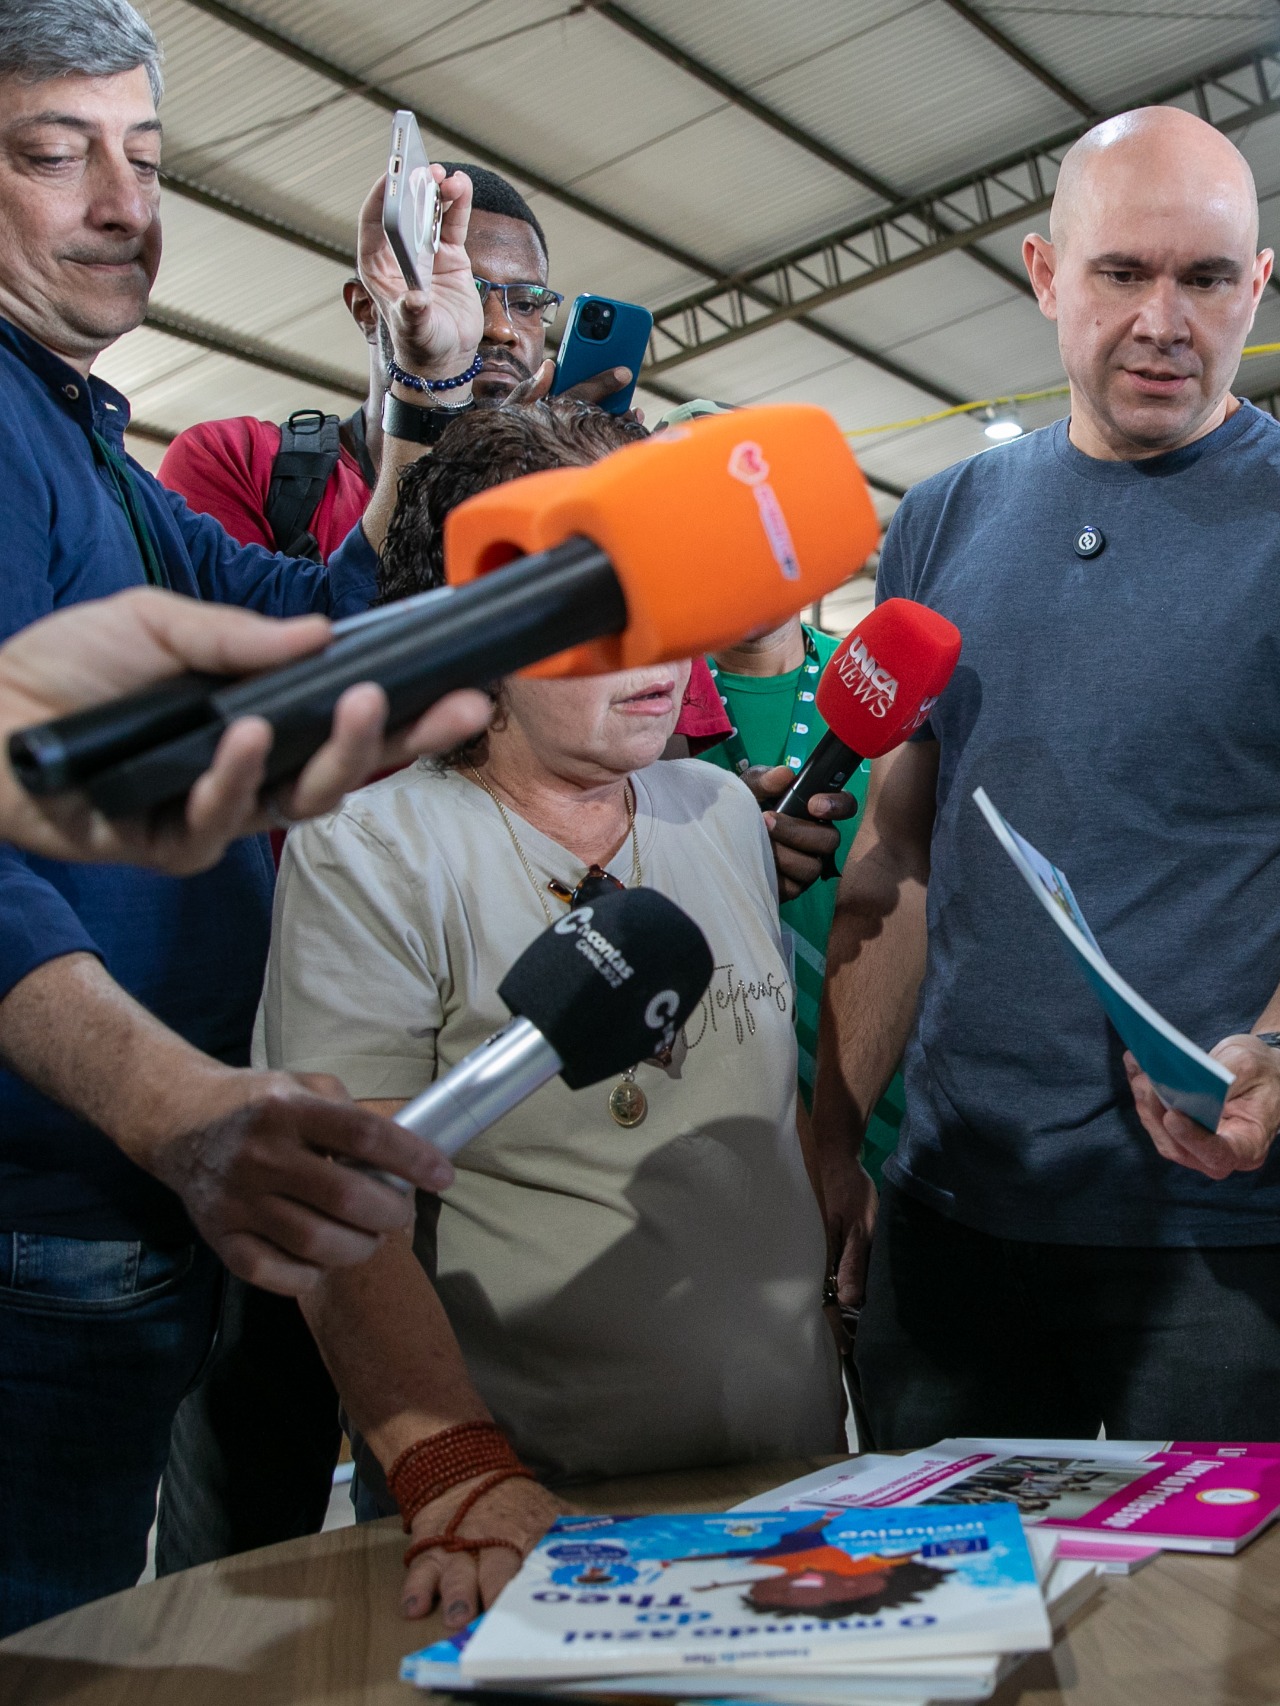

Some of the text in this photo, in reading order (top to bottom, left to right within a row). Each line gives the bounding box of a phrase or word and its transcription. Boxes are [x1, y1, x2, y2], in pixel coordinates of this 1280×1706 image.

[849, 635, 899, 702] UNICA
[834, 651, 893, 718] NEWS
[531, 1590, 690, 1608] Theo
[563, 1615, 938, 1645] O mundo azul
[635, 1610, 713, 1626] do
